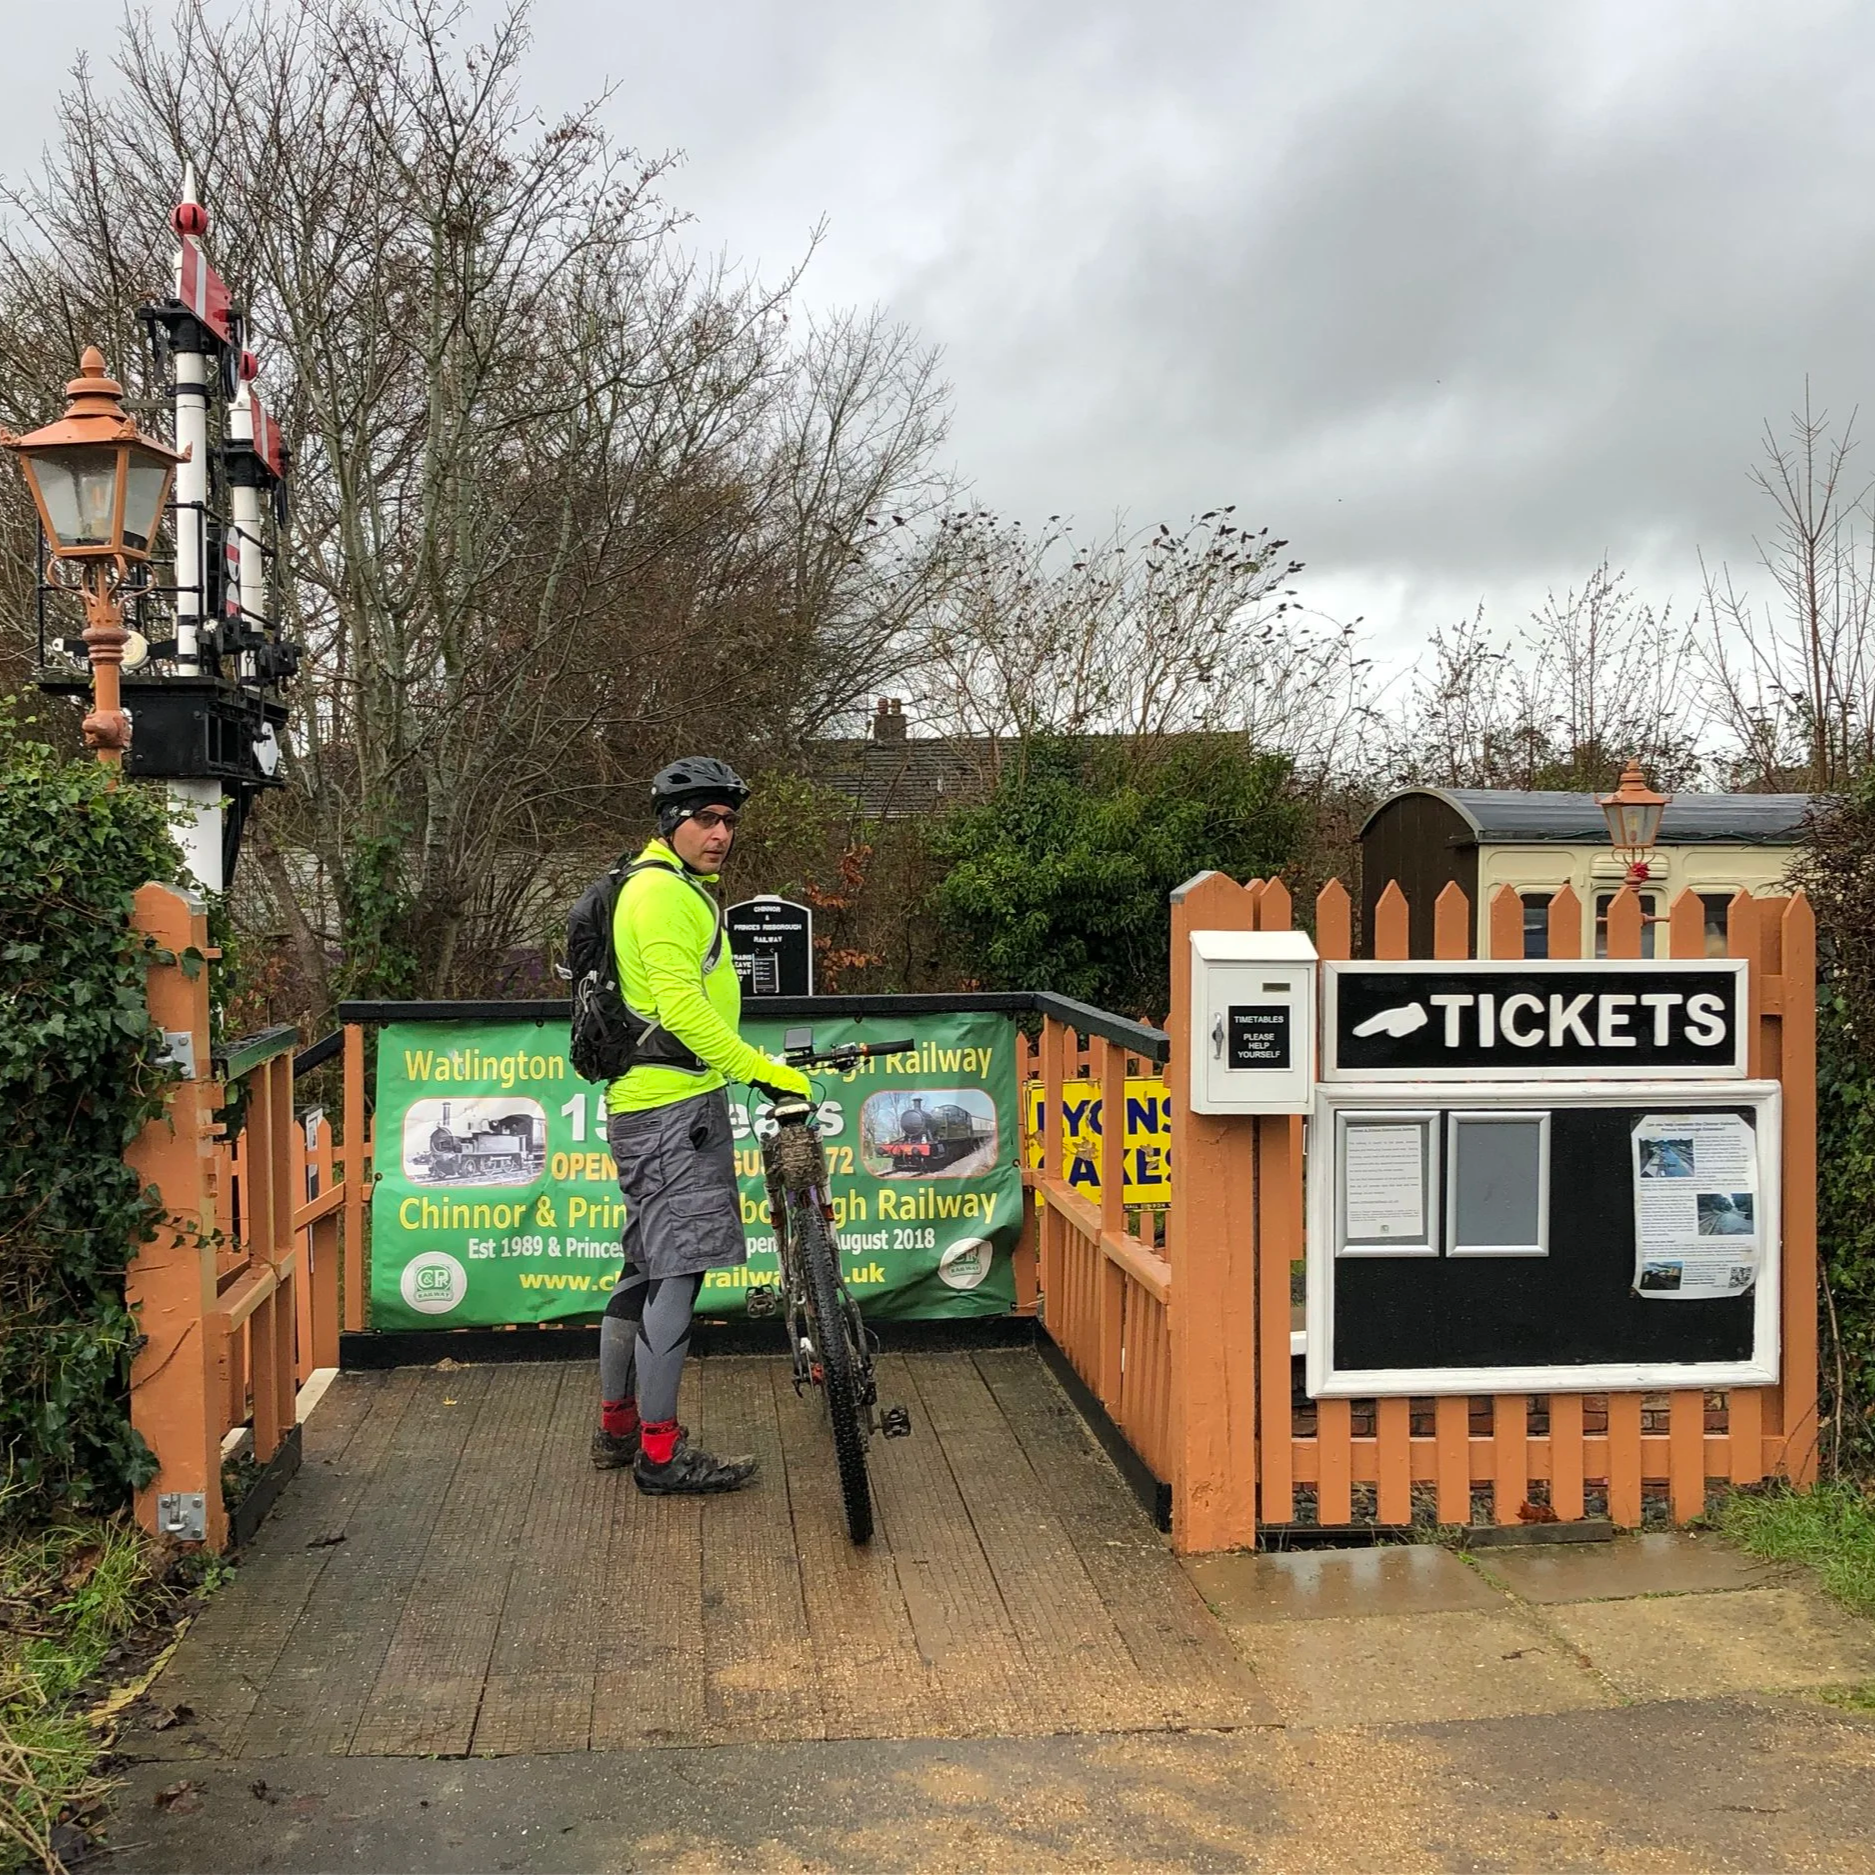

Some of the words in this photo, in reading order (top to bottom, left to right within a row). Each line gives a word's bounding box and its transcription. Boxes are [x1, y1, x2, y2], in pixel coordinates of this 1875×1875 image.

[1233, 1015, 1285, 1024] TIMETABLES
[1430, 993, 1727, 1048] TICKETS
[1243, 1033, 1275, 1041] PLEASE
[1248, 1042, 1270, 1050] HELP
[404, 1048, 564, 1088] Watlington
[886, 1042, 994, 1078] Railway
[1237, 1050, 1281, 1059] YOURSELF
[551, 1152, 618, 1181] OPEN
[399, 1197, 526, 1231] Chinnor
[535, 1196, 557, 1228] &
[568, 1197, 627, 1229] Prin
[878, 1187, 998, 1225] Railway
[468, 1238, 496, 1259] Est
[501, 1235, 543, 1258] 1989
[548, 1236, 562, 1257] &
[893, 1227, 935, 1250] 2018
